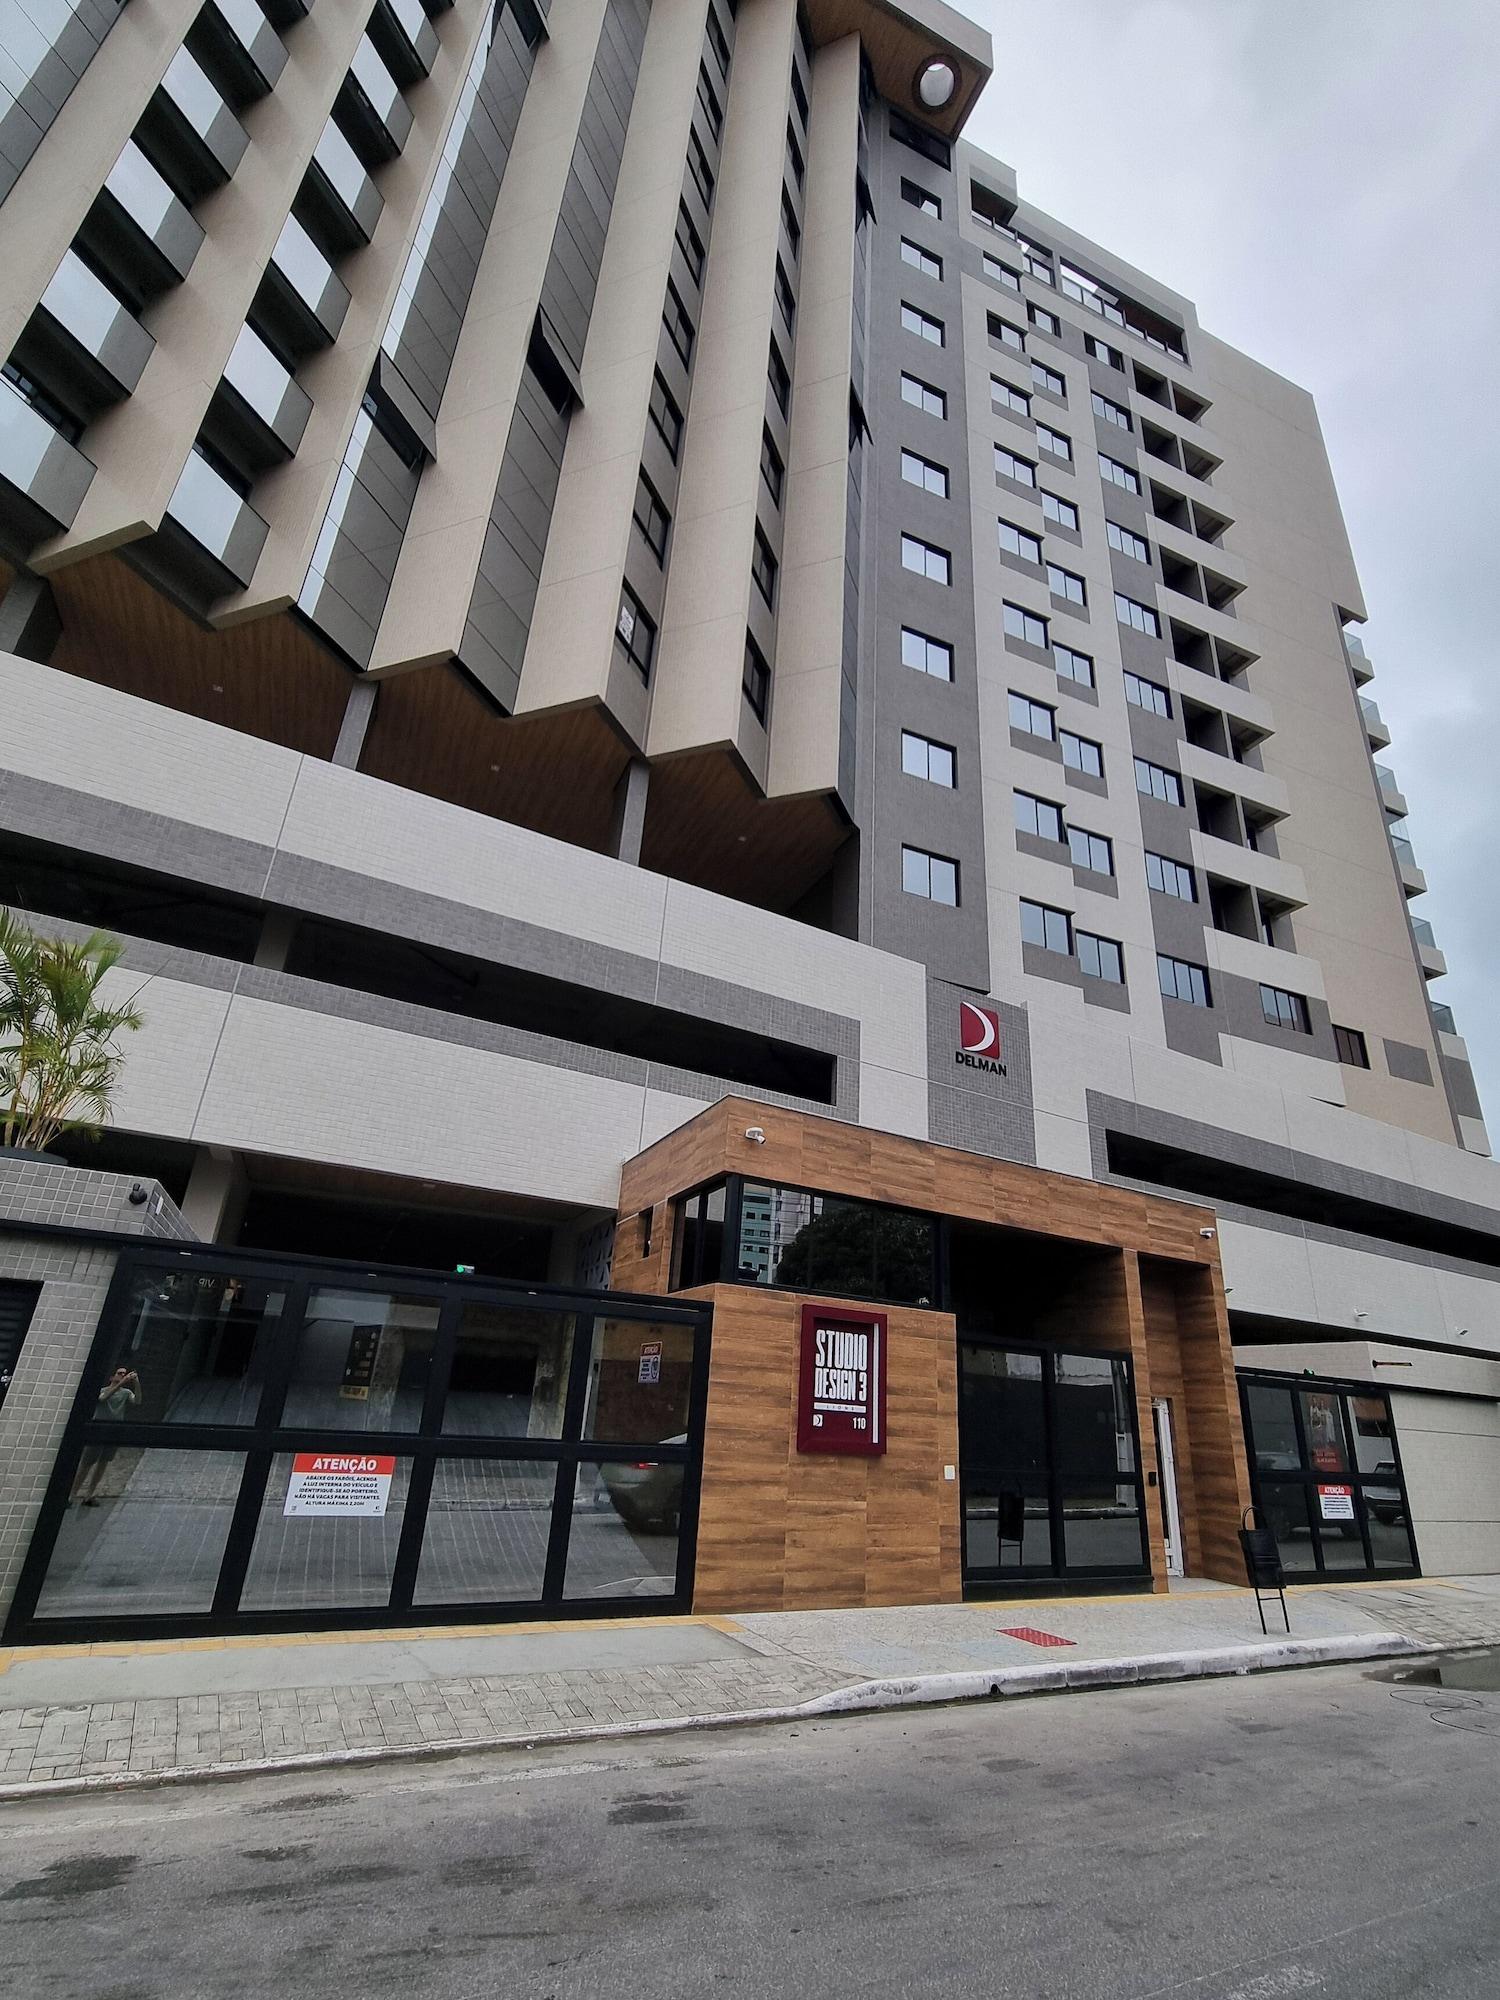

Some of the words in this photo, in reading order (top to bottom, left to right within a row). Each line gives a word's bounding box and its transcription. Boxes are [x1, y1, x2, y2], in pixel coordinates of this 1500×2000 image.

[955, 1051, 1007, 1077] DELMAN
[815, 1329, 868, 1371] STUDIO
[814, 1367, 856, 1401] DESIGN
[858, 1371, 867, 1402] 3
[852, 1417, 867, 1430] 110
[312, 1456, 377, 1473] ATENÇÃO
